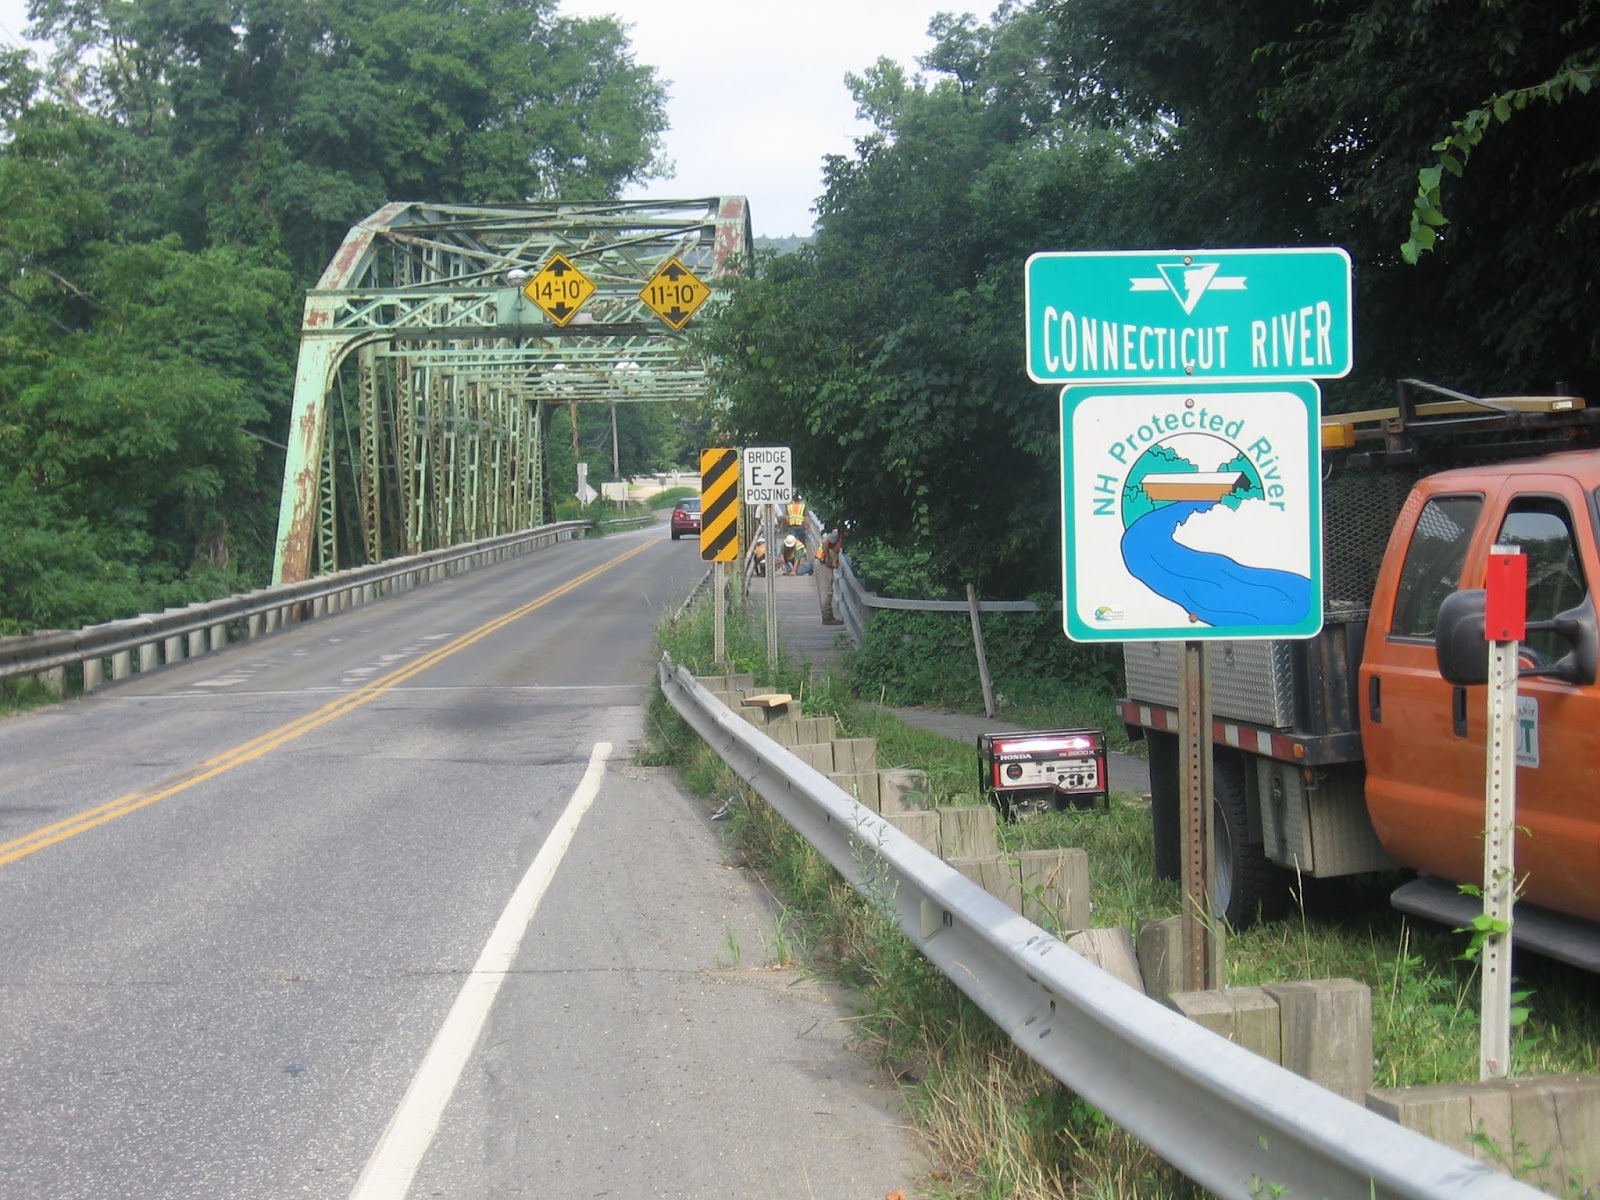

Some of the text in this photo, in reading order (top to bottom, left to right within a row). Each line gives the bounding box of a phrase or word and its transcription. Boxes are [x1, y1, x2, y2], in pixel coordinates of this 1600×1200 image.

[1043, 300, 1332, 372] CONNECTICUT RIVER
[748, 451, 787, 463] BRIDGE
[1093, 407, 1285, 516] NH Protected River
[751, 465, 785, 486] E-2
[746, 488, 790, 501] POSTING
[1000, 753, 1032, 761] HONDA
